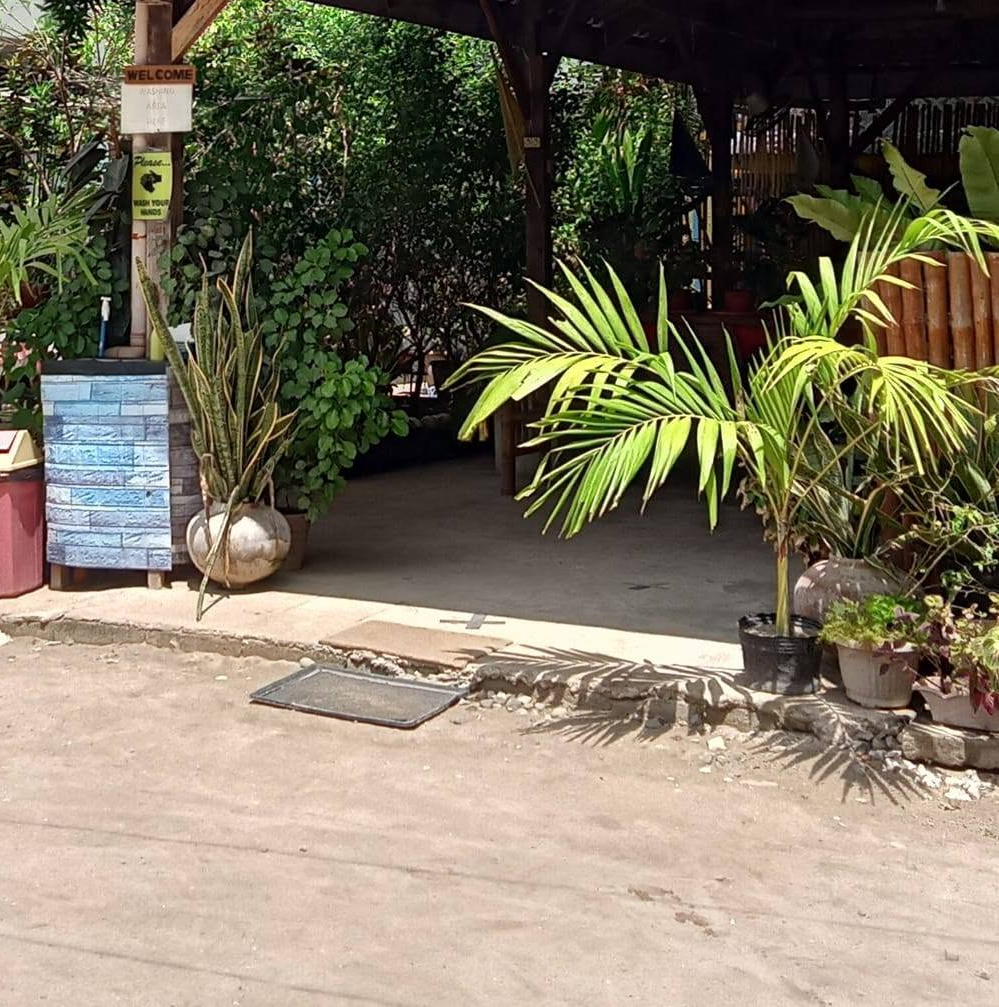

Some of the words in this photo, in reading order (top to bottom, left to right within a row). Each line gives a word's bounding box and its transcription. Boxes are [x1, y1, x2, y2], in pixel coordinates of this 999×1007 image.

[127, 69, 194, 81] WELCOME
[133, 199, 150, 208] WASH
[151, 199, 170, 208] YOUR
[140, 208, 162, 216] HANDS
